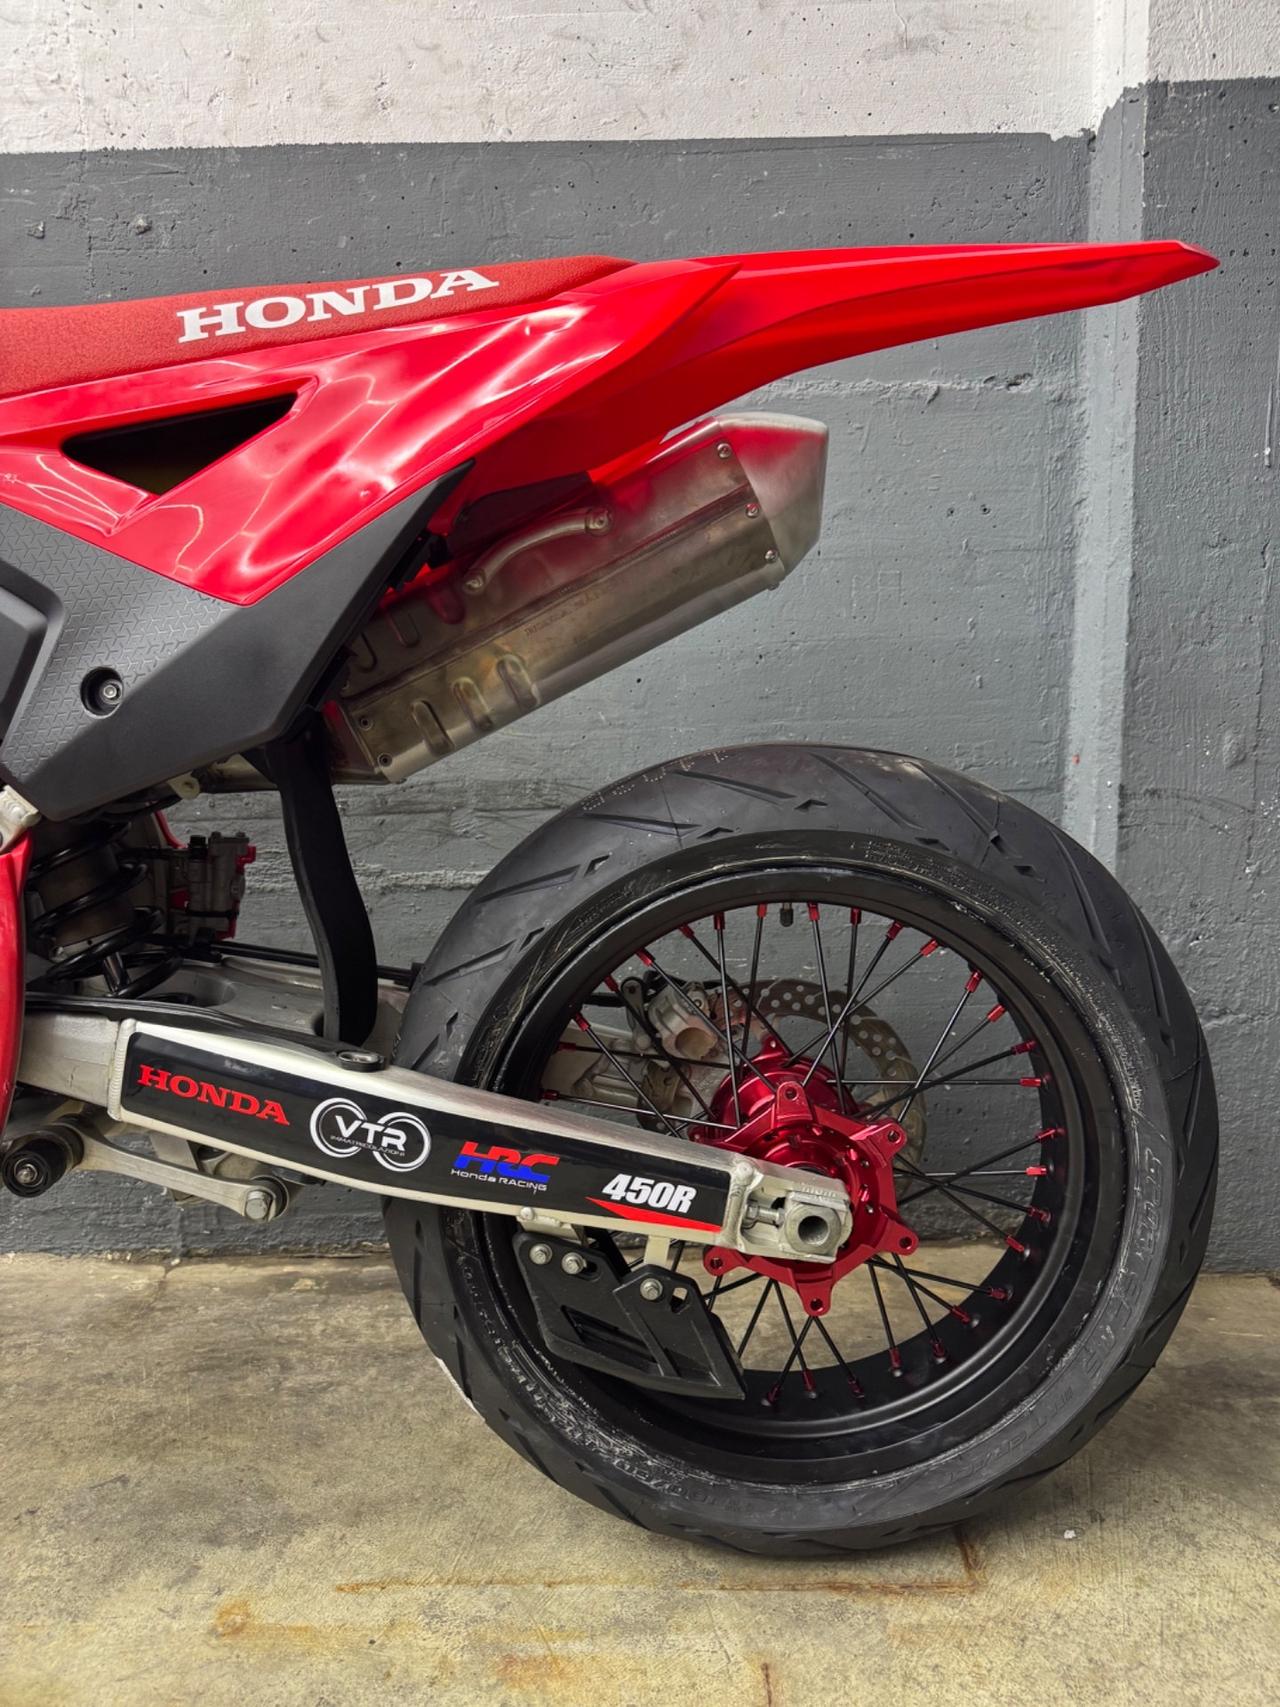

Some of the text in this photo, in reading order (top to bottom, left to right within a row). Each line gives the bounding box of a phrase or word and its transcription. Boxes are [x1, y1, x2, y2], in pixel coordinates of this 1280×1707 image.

[176, 269, 499, 343] HONDA
[137, 1064, 290, 1126] HONDA
[335, 1115, 407, 1151] VTR
[450, 1168, 548, 1192] Honda RACING
[453, 1140, 560, 1183] HRC
[602, 1173, 697, 1214] 450R
